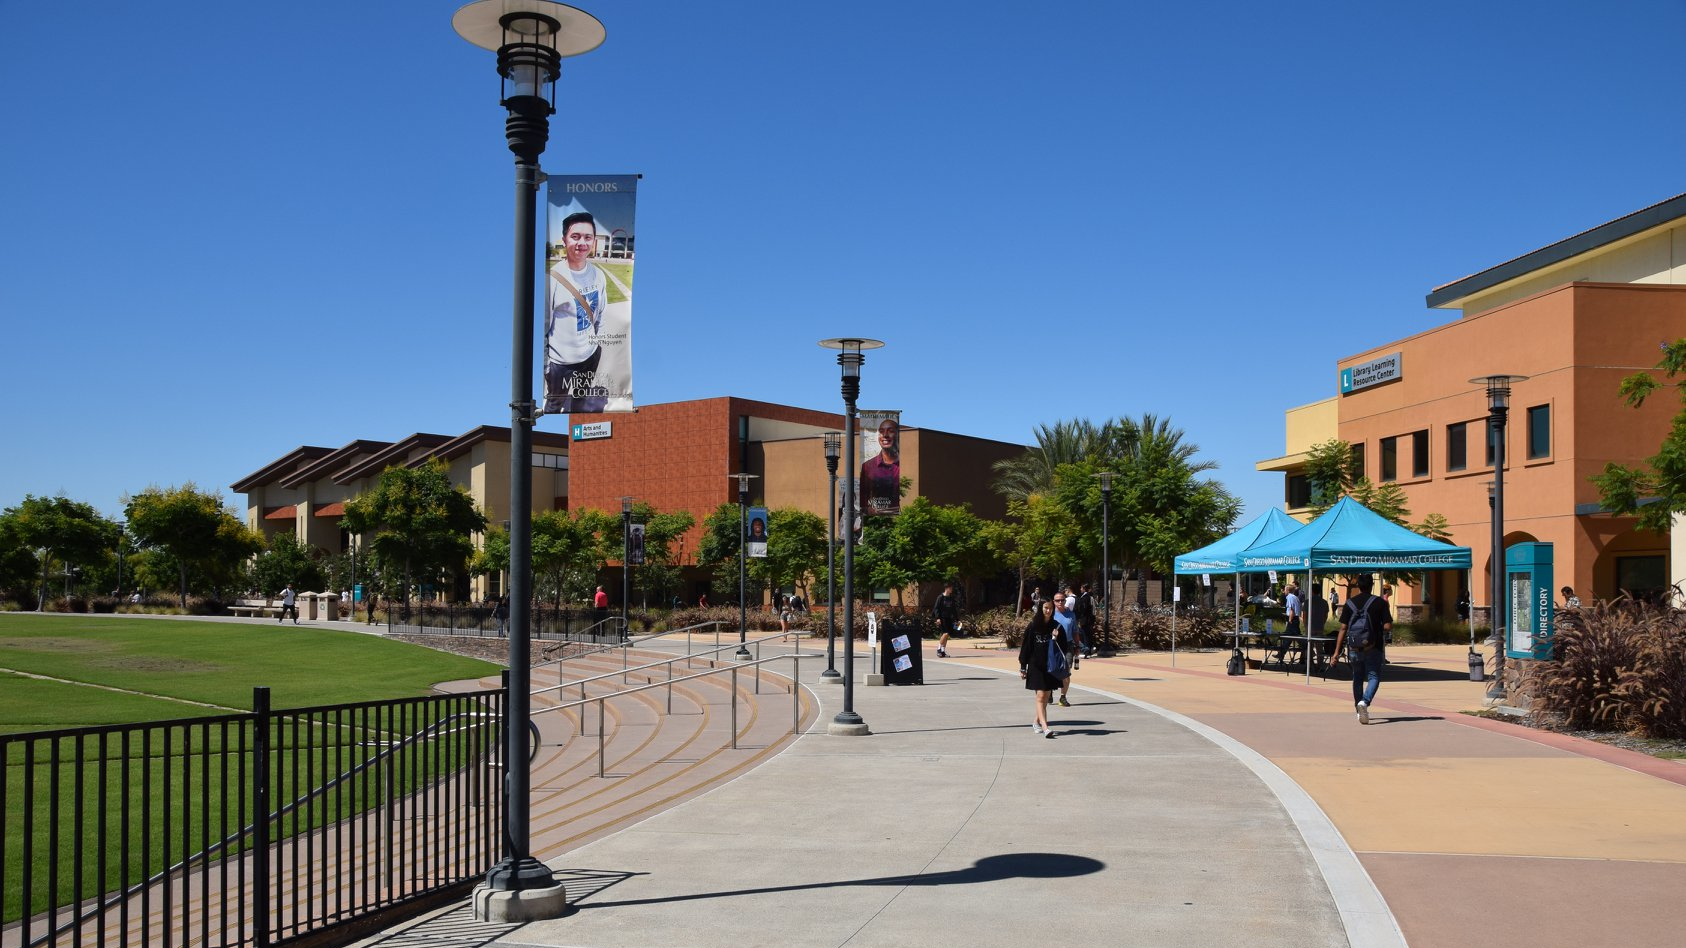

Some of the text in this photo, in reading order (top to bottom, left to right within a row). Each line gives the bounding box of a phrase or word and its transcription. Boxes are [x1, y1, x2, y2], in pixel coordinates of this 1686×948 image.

[566, 182, 618, 193] HONORS
[1353, 359, 1395, 377] Library Learning
[572, 370, 587, 379] SAN
[1344, 374, 1349, 387] L
[1353, 369, 1395, 387] Resource Center
[571, 387, 609, 399] COLLEGE
[574, 427, 580, 437] H
[583, 430, 608, 438] Humanities
[1330, 553, 1454, 566] SAN DIEGO MIRAMAR COLLEGE
[1540, 587, 1548, 638] DIRECTORY
